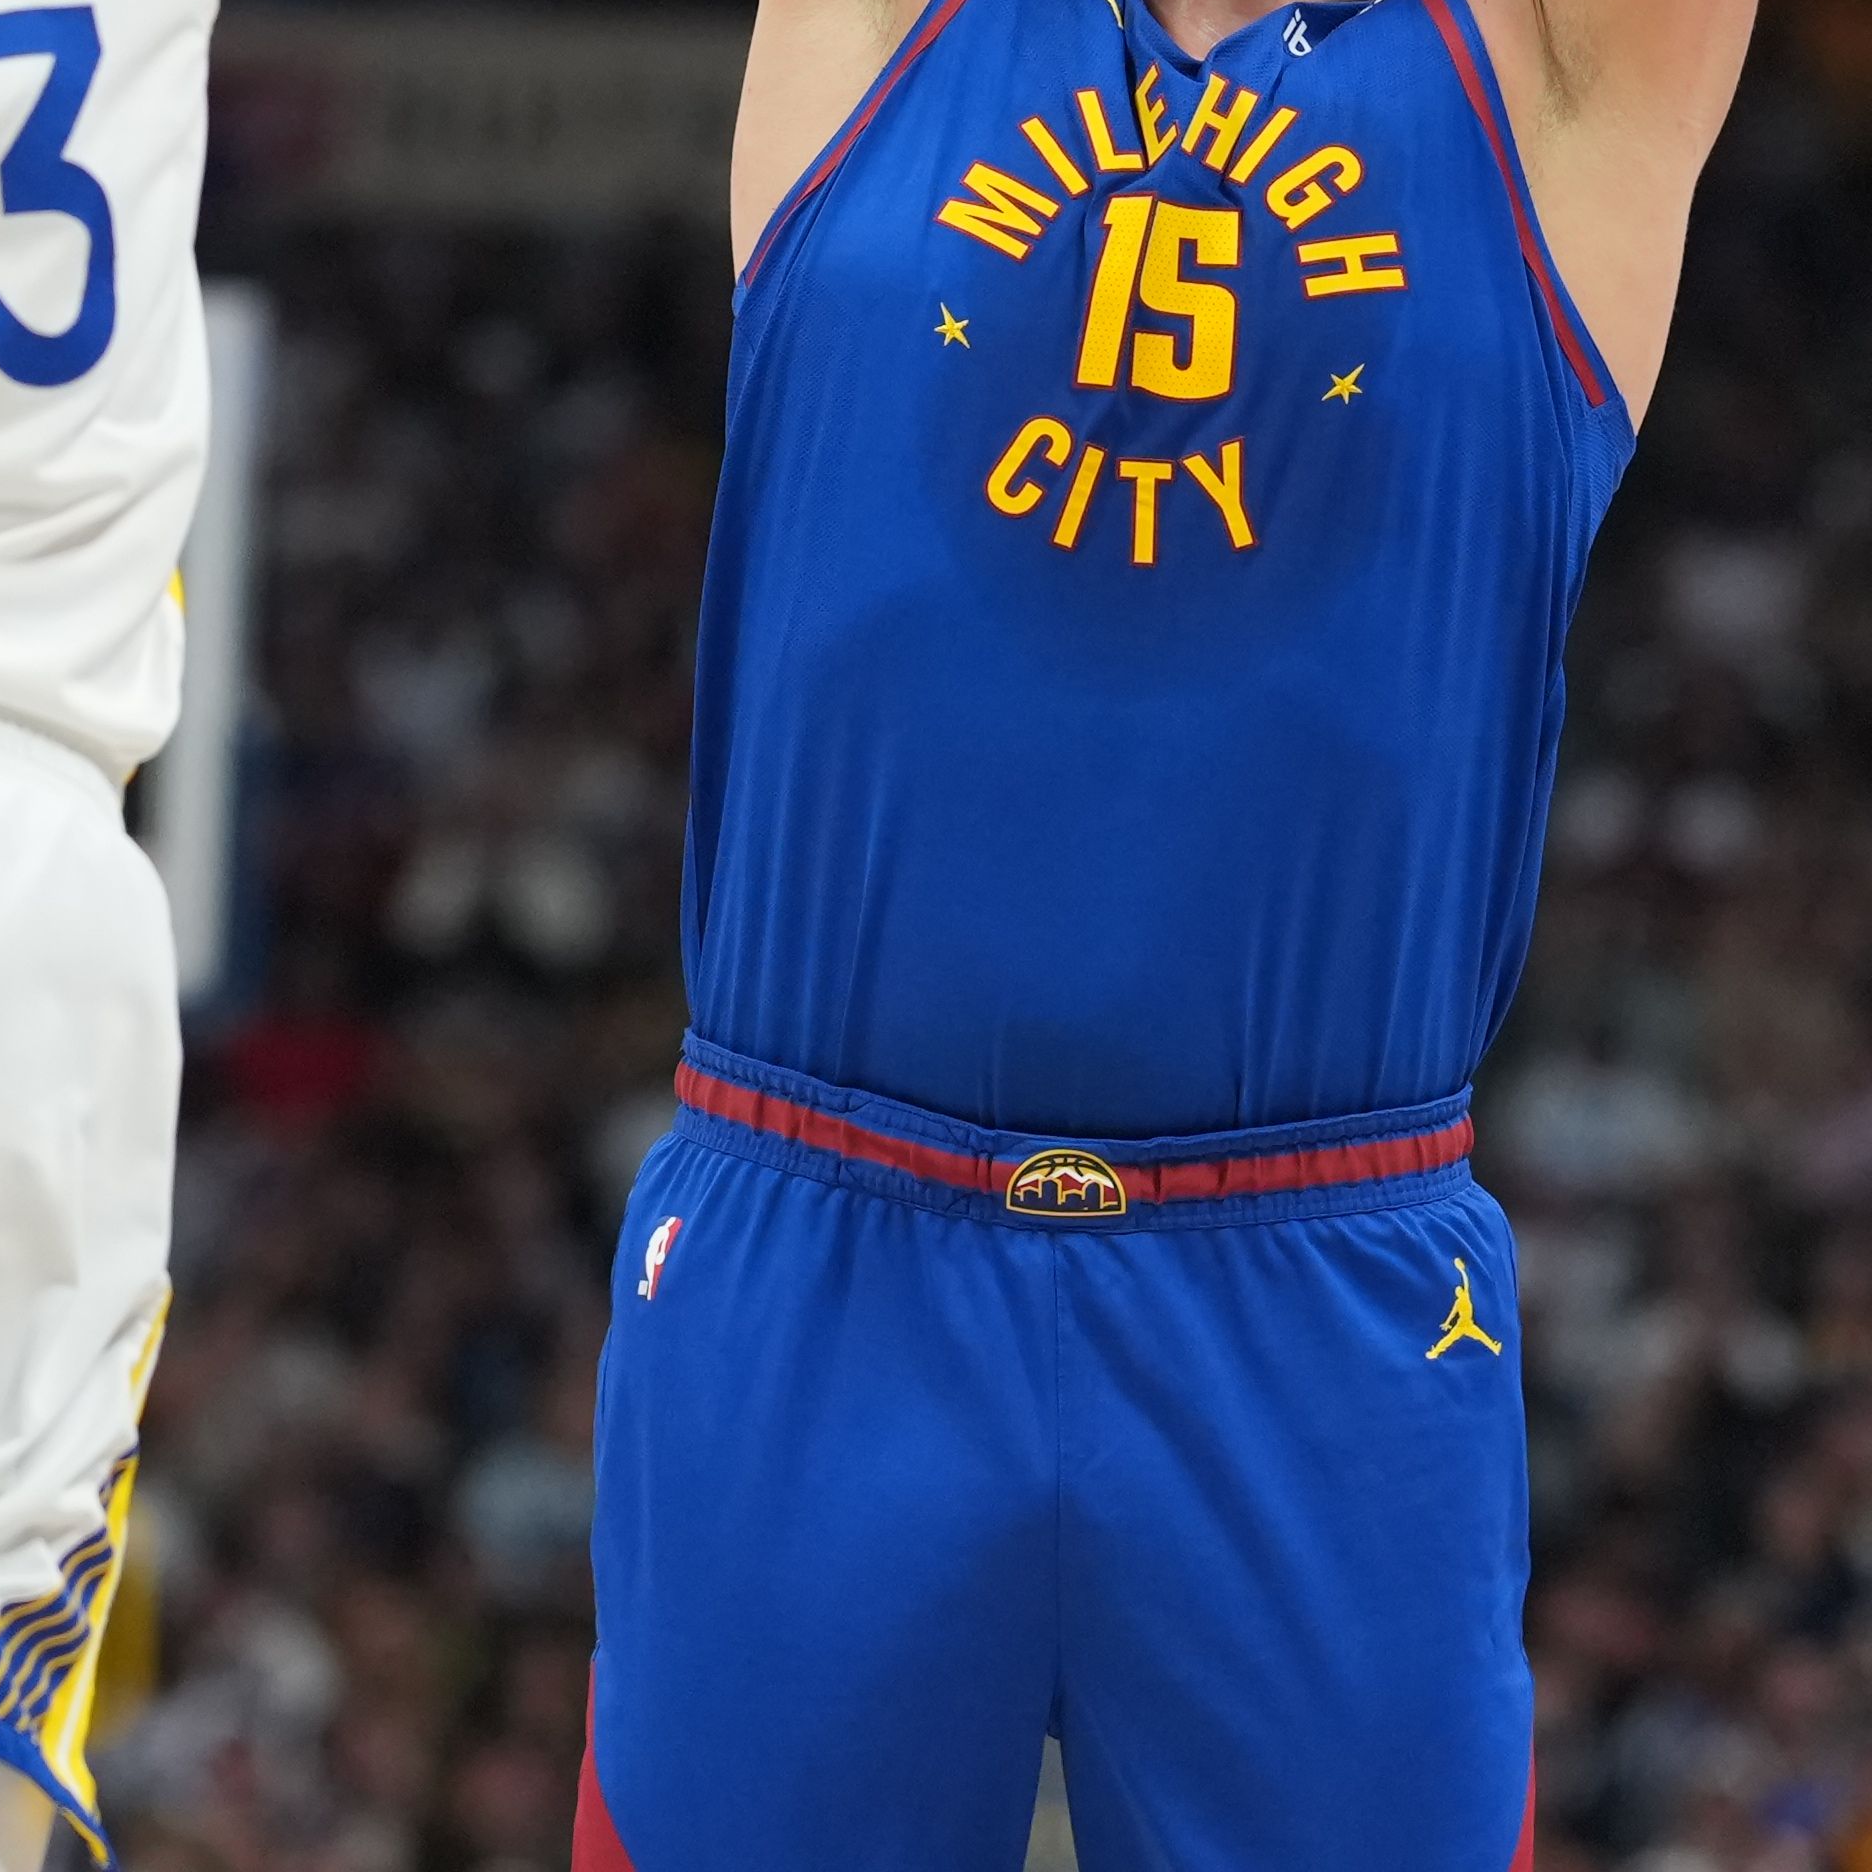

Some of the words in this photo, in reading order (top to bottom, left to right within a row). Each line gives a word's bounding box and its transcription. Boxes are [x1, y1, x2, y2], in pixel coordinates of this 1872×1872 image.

[934, 63, 1178, 262] MILE
[1180, 72, 1408, 299] HIGH
[1074, 193, 1244, 403] 15
[985, 415, 1258, 567] CITY
